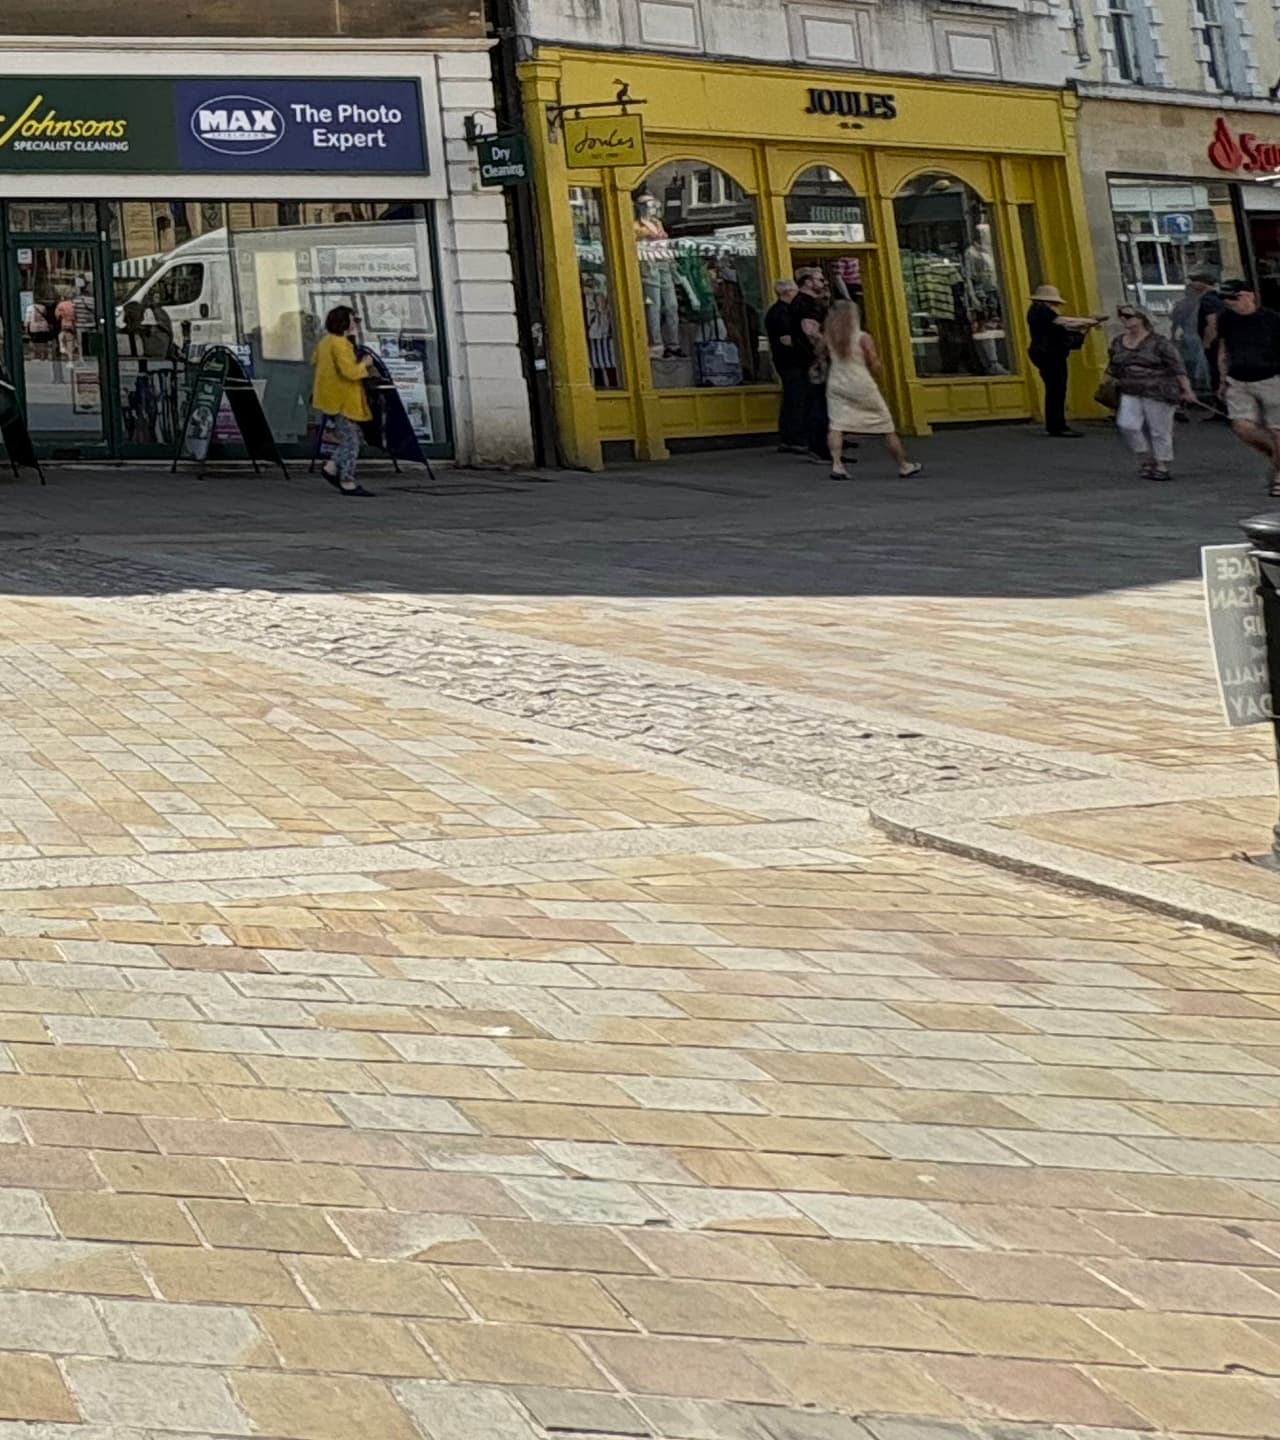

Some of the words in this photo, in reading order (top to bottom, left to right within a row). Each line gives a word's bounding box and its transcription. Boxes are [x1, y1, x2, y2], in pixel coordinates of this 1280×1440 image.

[290, 104, 333, 123] The
[338, 104, 402, 124] Photo
[804, 87, 897, 120] JOULES
[198, 109, 277, 131] MAX
[13, 140, 73, 151] SPECIALIST
[74, 140, 129, 152] CLEANING
[312, 128, 387, 152] Expert
[574, 126, 634, 154] Joules
[491, 146, 511, 161] Dry
[1239, 133, 1280, 171] Sa
[482, 162, 526, 178] Cleaning
